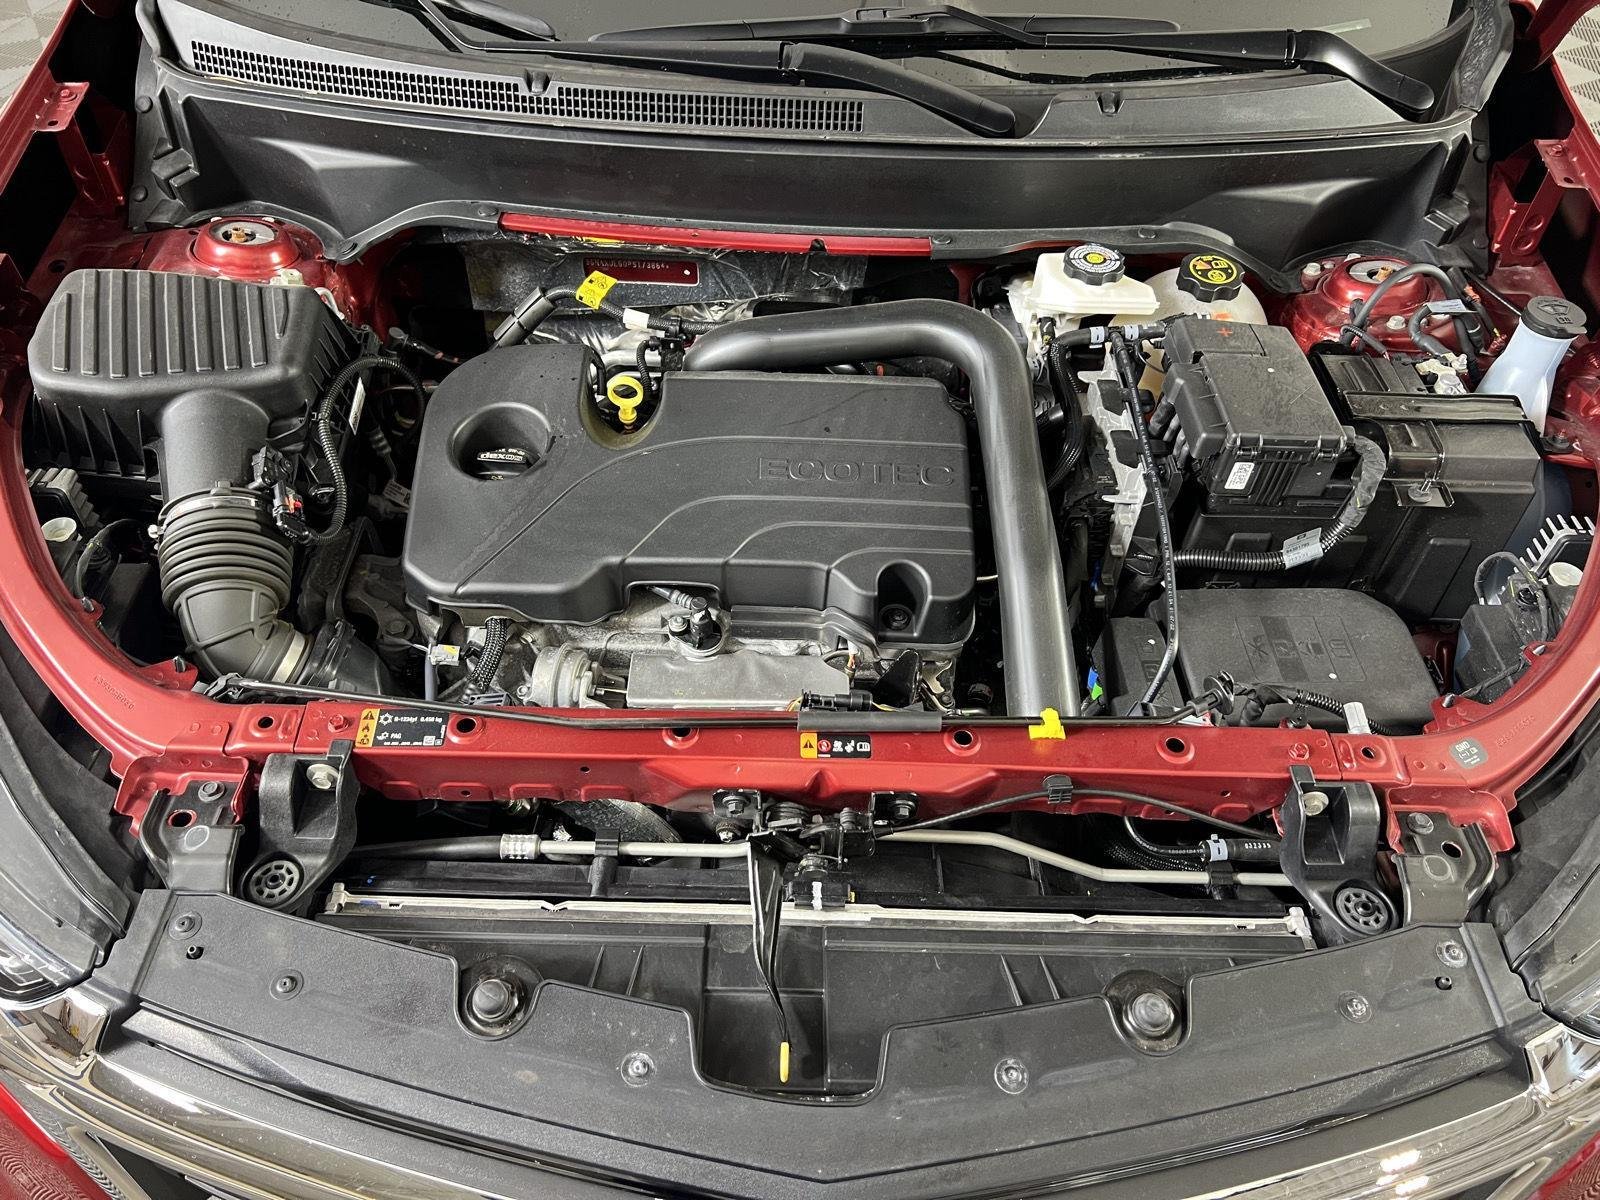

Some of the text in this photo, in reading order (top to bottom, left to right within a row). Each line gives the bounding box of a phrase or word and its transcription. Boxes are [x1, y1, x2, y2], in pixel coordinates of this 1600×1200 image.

[480, 451, 523, 462] dexos
[758, 457, 954, 488] ECOTEC
[1455, 741, 1471, 751] GND
